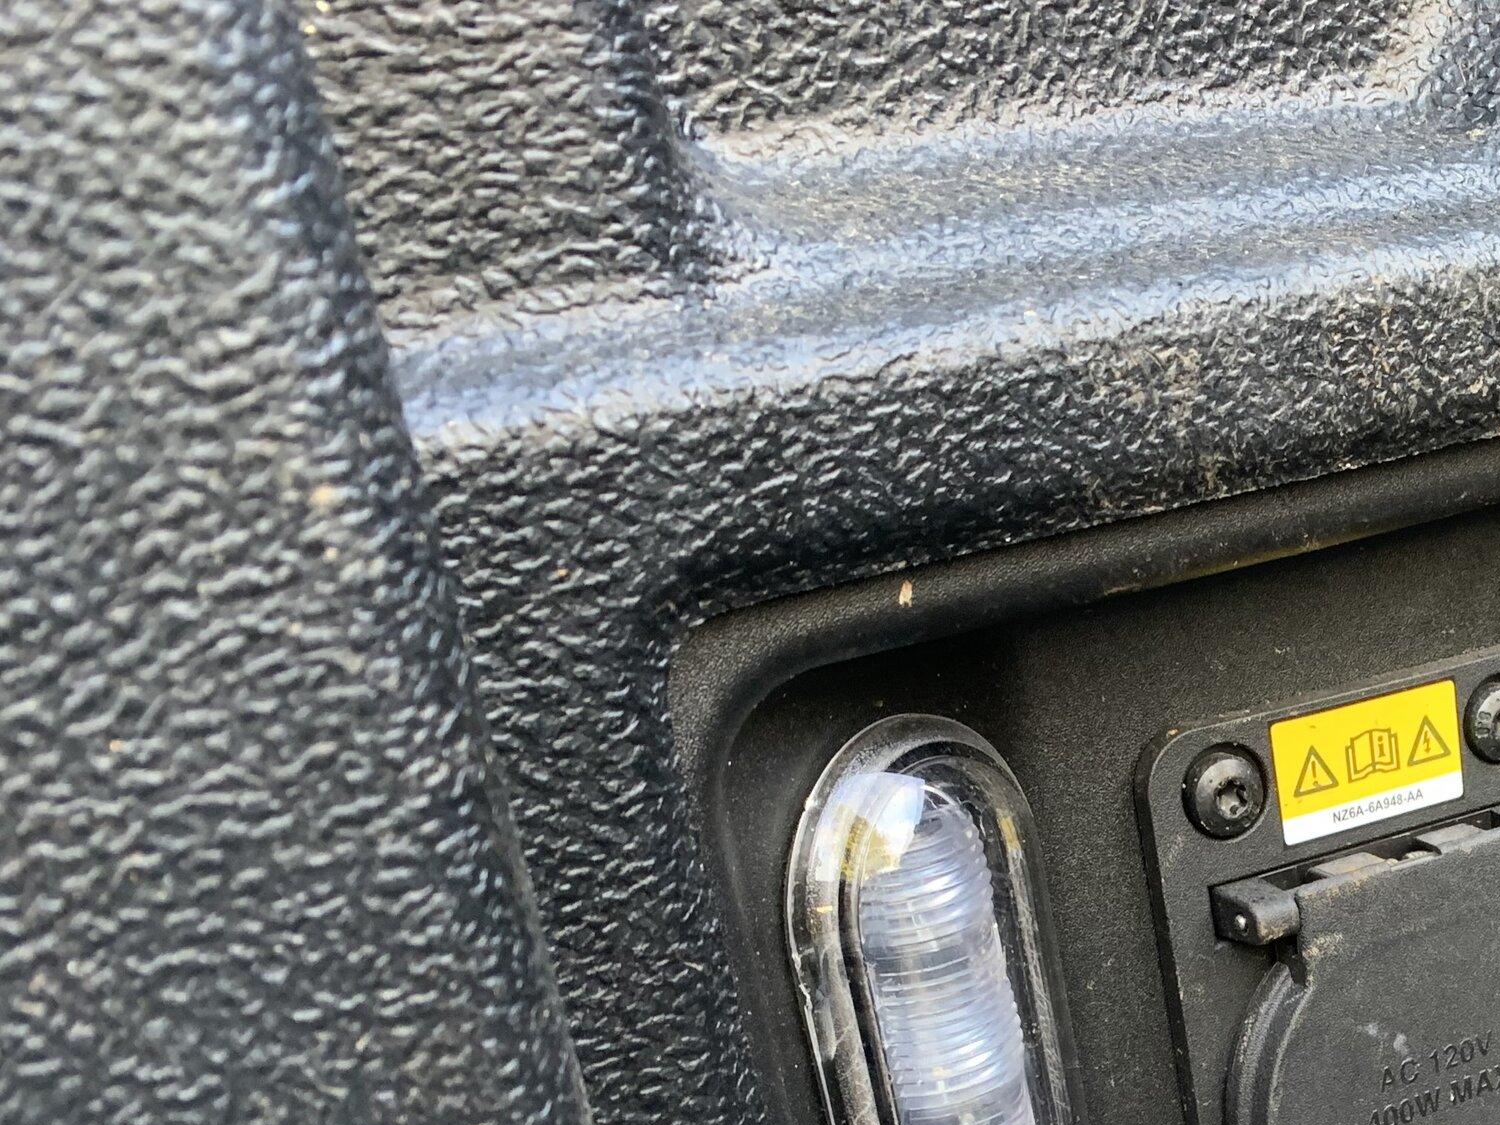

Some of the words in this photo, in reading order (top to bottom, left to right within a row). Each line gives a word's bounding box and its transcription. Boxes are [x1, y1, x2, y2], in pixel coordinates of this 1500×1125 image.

[1332, 789, 1423, 823] NZ6A-6A948-AA
[1382, 1057, 1420, 1092] AC
[1429, 1030, 1492, 1073] 120V
